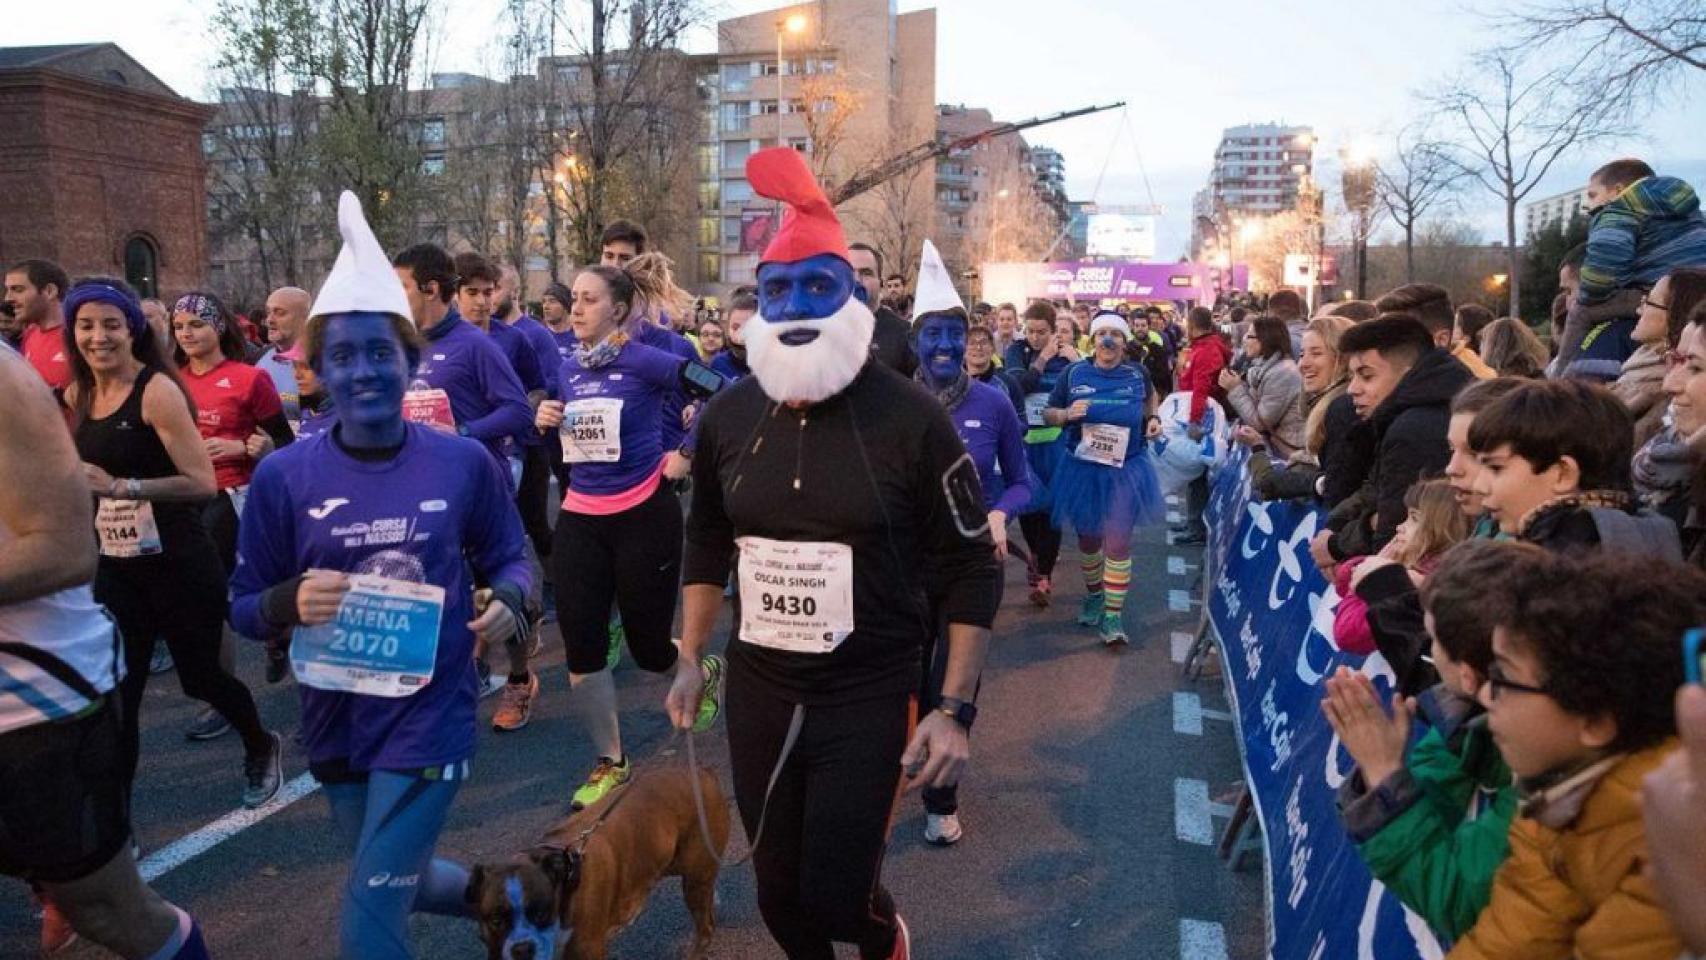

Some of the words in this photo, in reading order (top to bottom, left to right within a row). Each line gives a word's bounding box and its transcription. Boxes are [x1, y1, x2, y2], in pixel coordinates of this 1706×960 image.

[572, 415, 604, 426] LAURA
[573, 427, 606, 441] 12061
[372, 517, 407, 531] CURSA
[754, 572, 786, 587] OSCAR
[788, 577, 826, 588] SINGH
[762, 592, 817, 616] 9430
[330, 629, 399, 658] 2070
